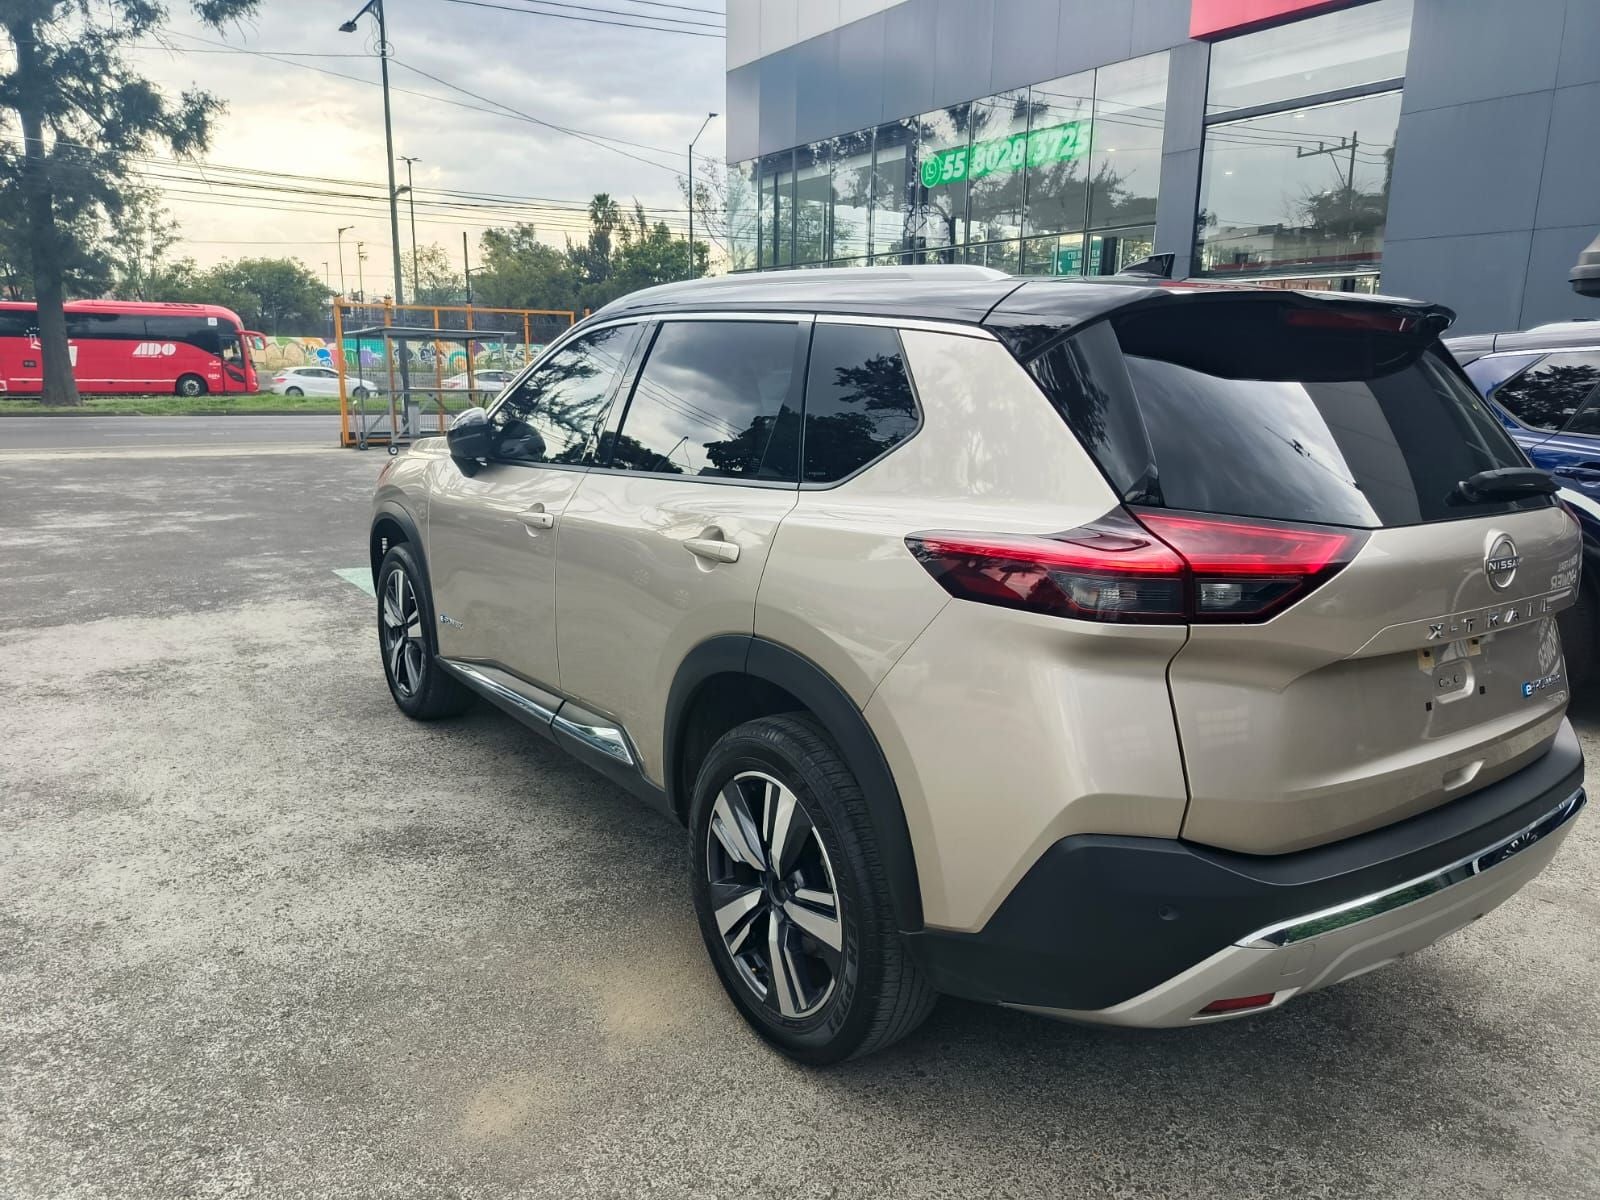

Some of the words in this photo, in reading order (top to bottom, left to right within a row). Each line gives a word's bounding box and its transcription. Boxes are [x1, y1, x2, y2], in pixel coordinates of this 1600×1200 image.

[941, 151, 966, 180] 55
[974, 138, 1025, 173] 8028
[1033, 125, 1092, 160] 3725
[132, 342, 177, 356] ADO
[1425, 598, 1553, 641] X-TRAIL
